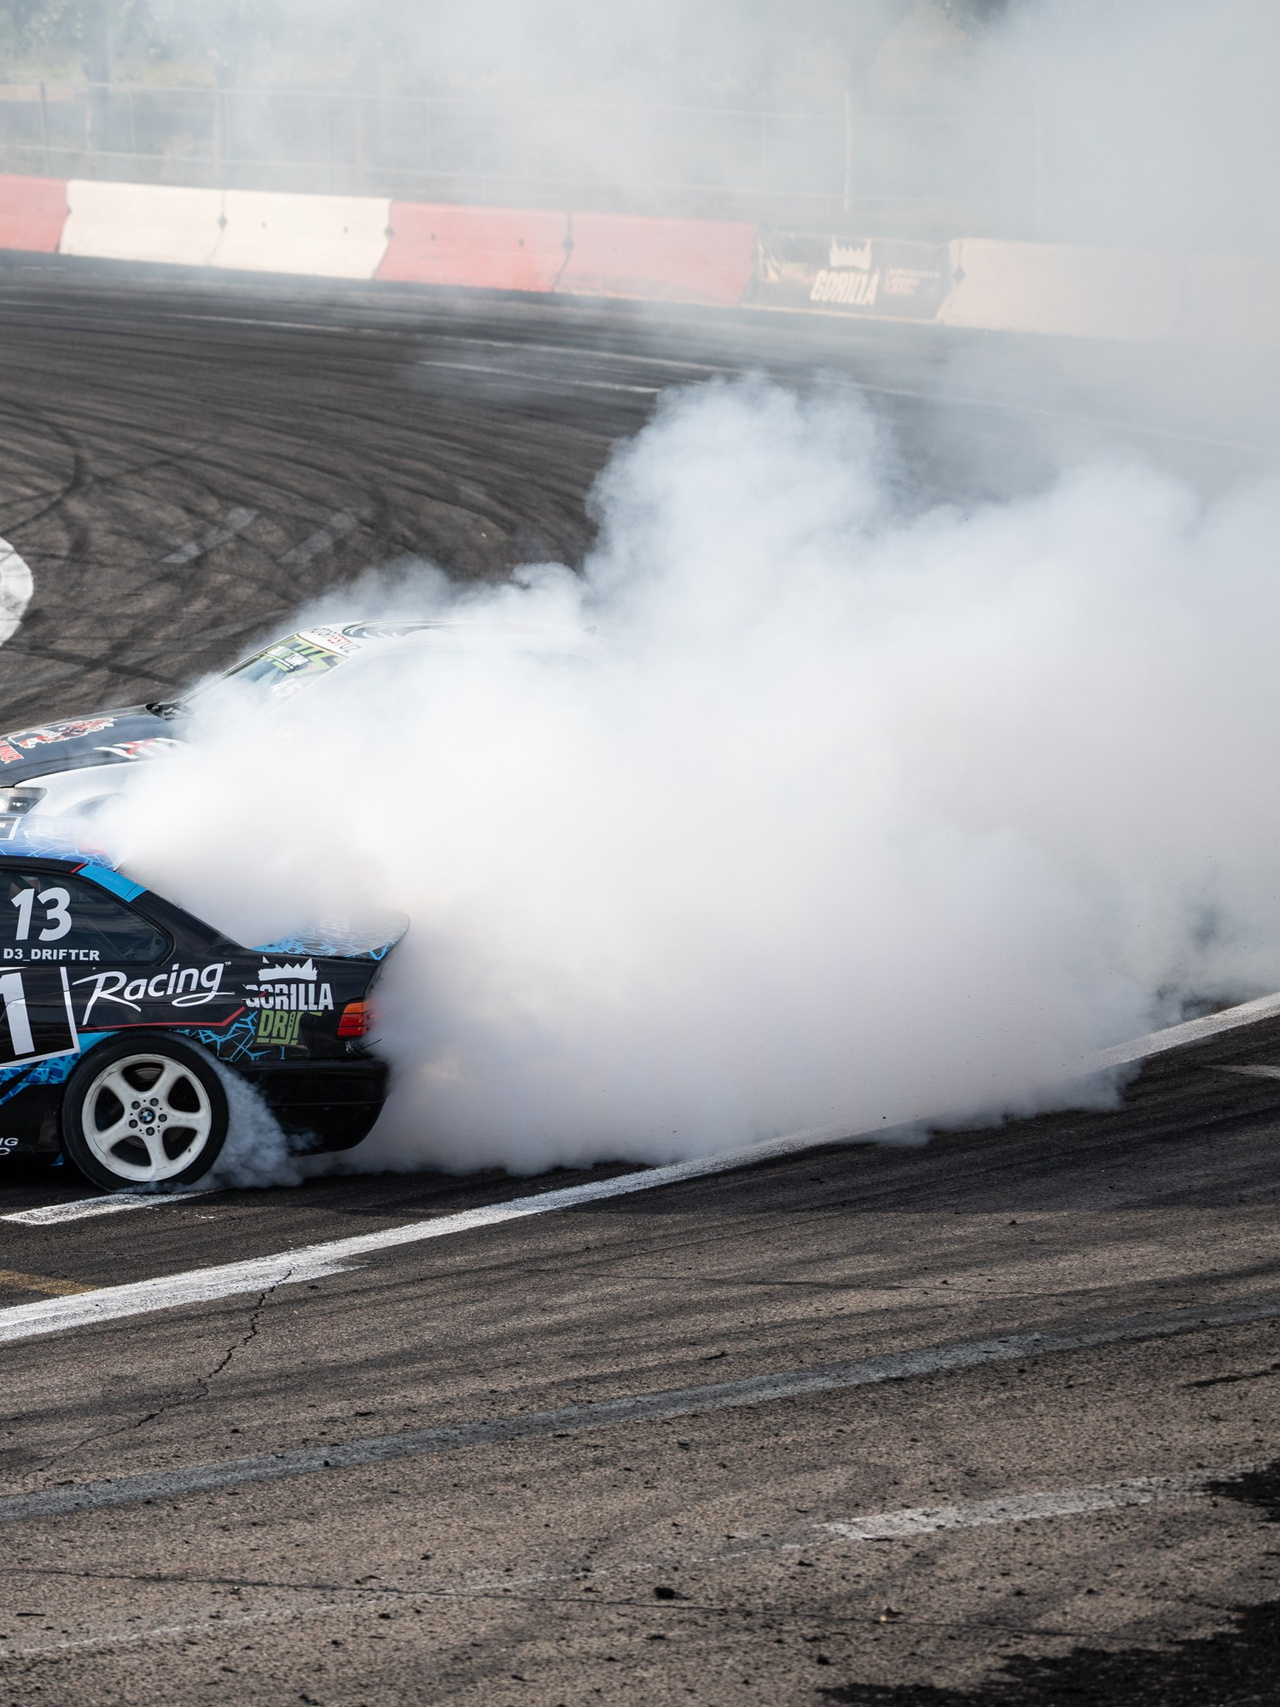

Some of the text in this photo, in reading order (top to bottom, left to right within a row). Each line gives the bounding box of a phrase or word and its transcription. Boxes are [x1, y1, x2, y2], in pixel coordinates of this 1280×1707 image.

[810, 268, 880, 306] GORILLA
[11, 887, 72, 941] 13
[3, 948, 100, 963] D3_DRIFTER
[72, 962, 235, 1026] Racing
[243, 983, 334, 1011] GORILLA
